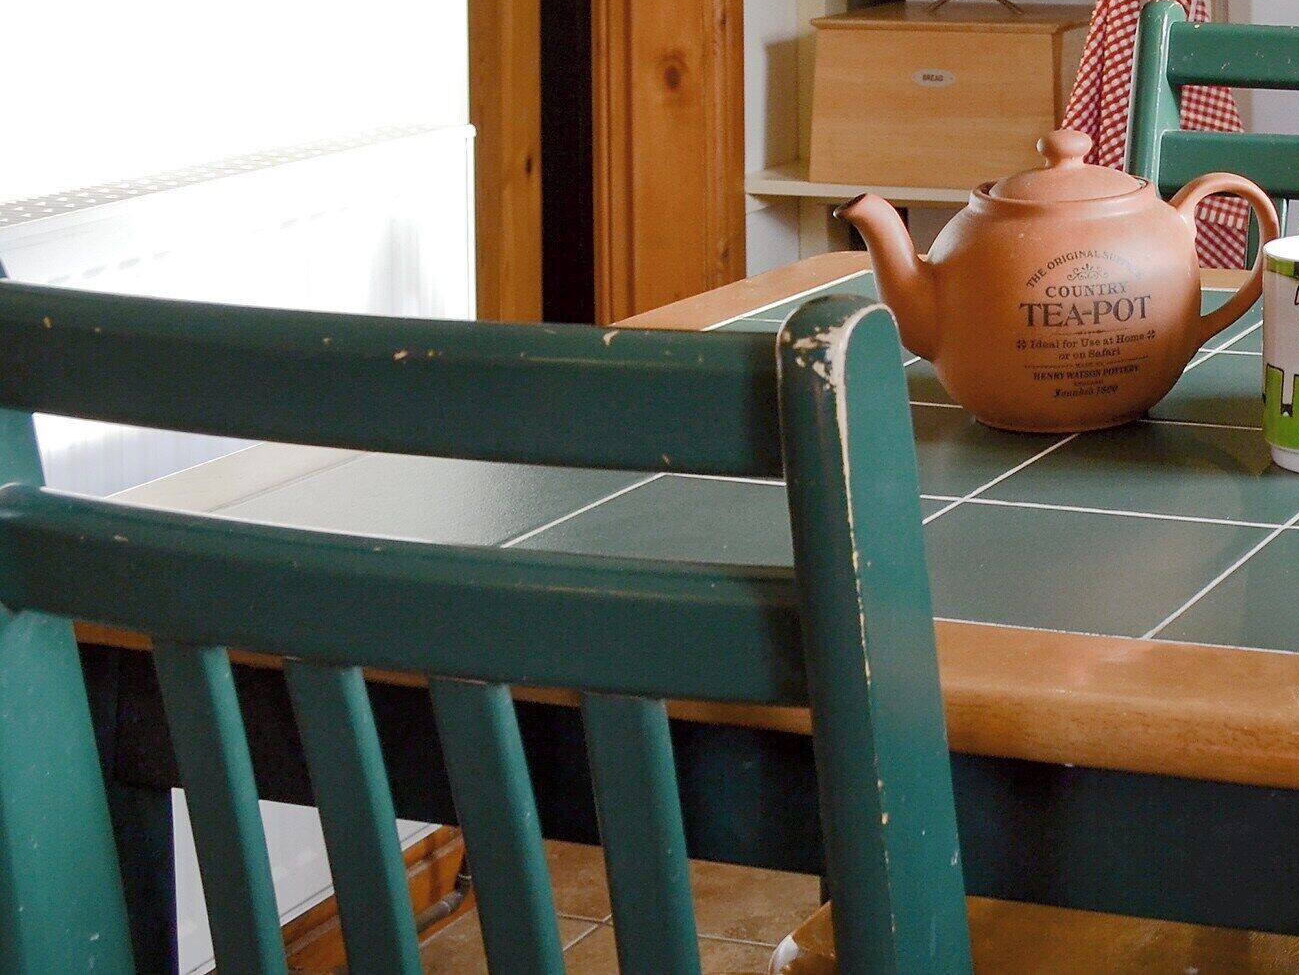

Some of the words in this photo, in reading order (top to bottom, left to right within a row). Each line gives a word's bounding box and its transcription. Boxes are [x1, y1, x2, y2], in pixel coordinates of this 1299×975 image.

[1026, 268, 1047, 288] THE
[1046, 249, 1101, 271] ORIGINAL
[1045, 281, 1129, 299] COUNTRY
[1019, 294, 1152, 327] TEA-POT
[1031, 338, 1059, 349] Ideal
[1062, 338, 1078, 349] for
[1080, 337, 1101, 348] Use
[1103, 336, 1114, 346] at
[1116, 333, 1145, 345] Home
[1058, 352, 1071, 361] or
[1073, 351, 1086, 360] on
[1088, 347, 1121, 359] Safari
[1033, 371, 1064, 381] HENRY
[1066, 368, 1102, 380] WATSON
[1103, 364, 1140, 376] POTTERY
